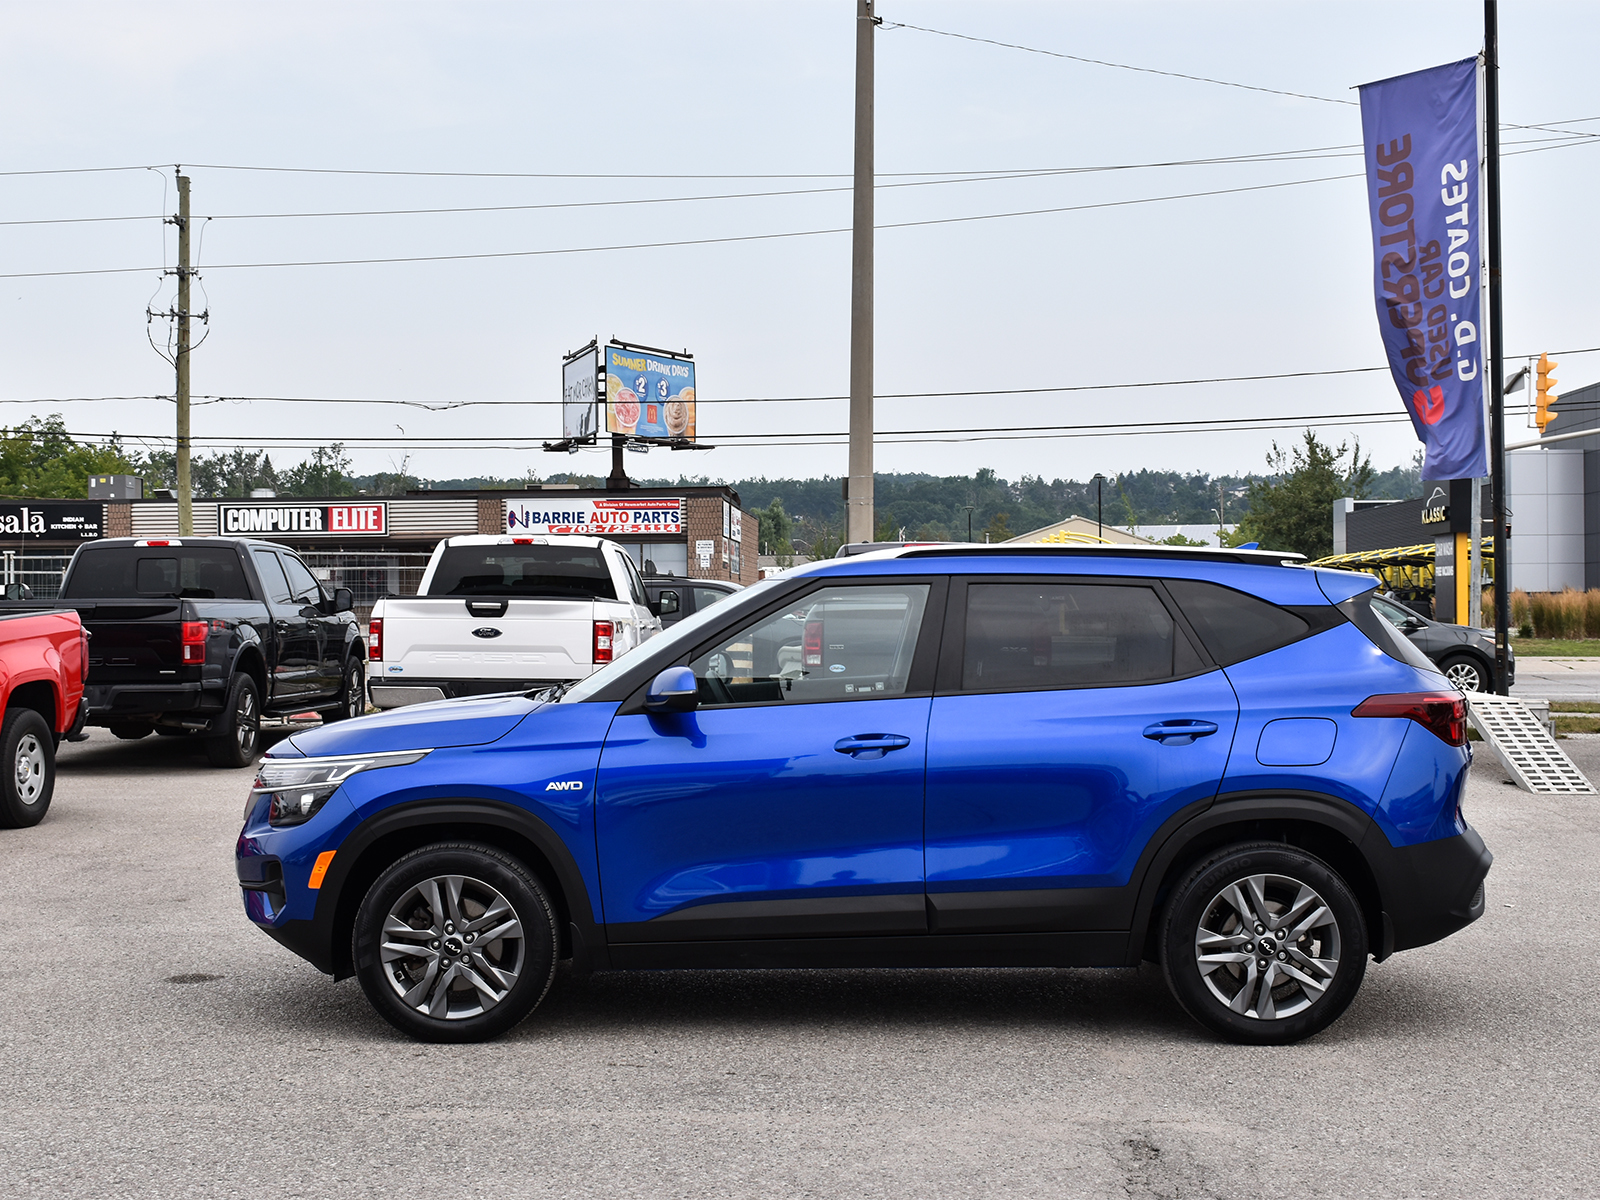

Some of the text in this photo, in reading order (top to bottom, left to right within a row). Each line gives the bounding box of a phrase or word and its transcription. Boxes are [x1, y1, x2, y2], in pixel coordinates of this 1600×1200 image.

[612, 353, 690, 378] SUMMER DRINK DAYS
[226, 507, 378, 531] COMPUTER ELITE
[532, 511, 679, 524] BARRIE AUTO PARTS
[1422, 506, 1446, 524] KLASSIC
[569, 524, 677, 532] 705-725-1114
[478, 628, 495, 636] Ford
[545, 781, 583, 791] AWD
[1197, 858, 1251, 896] KUMHO
